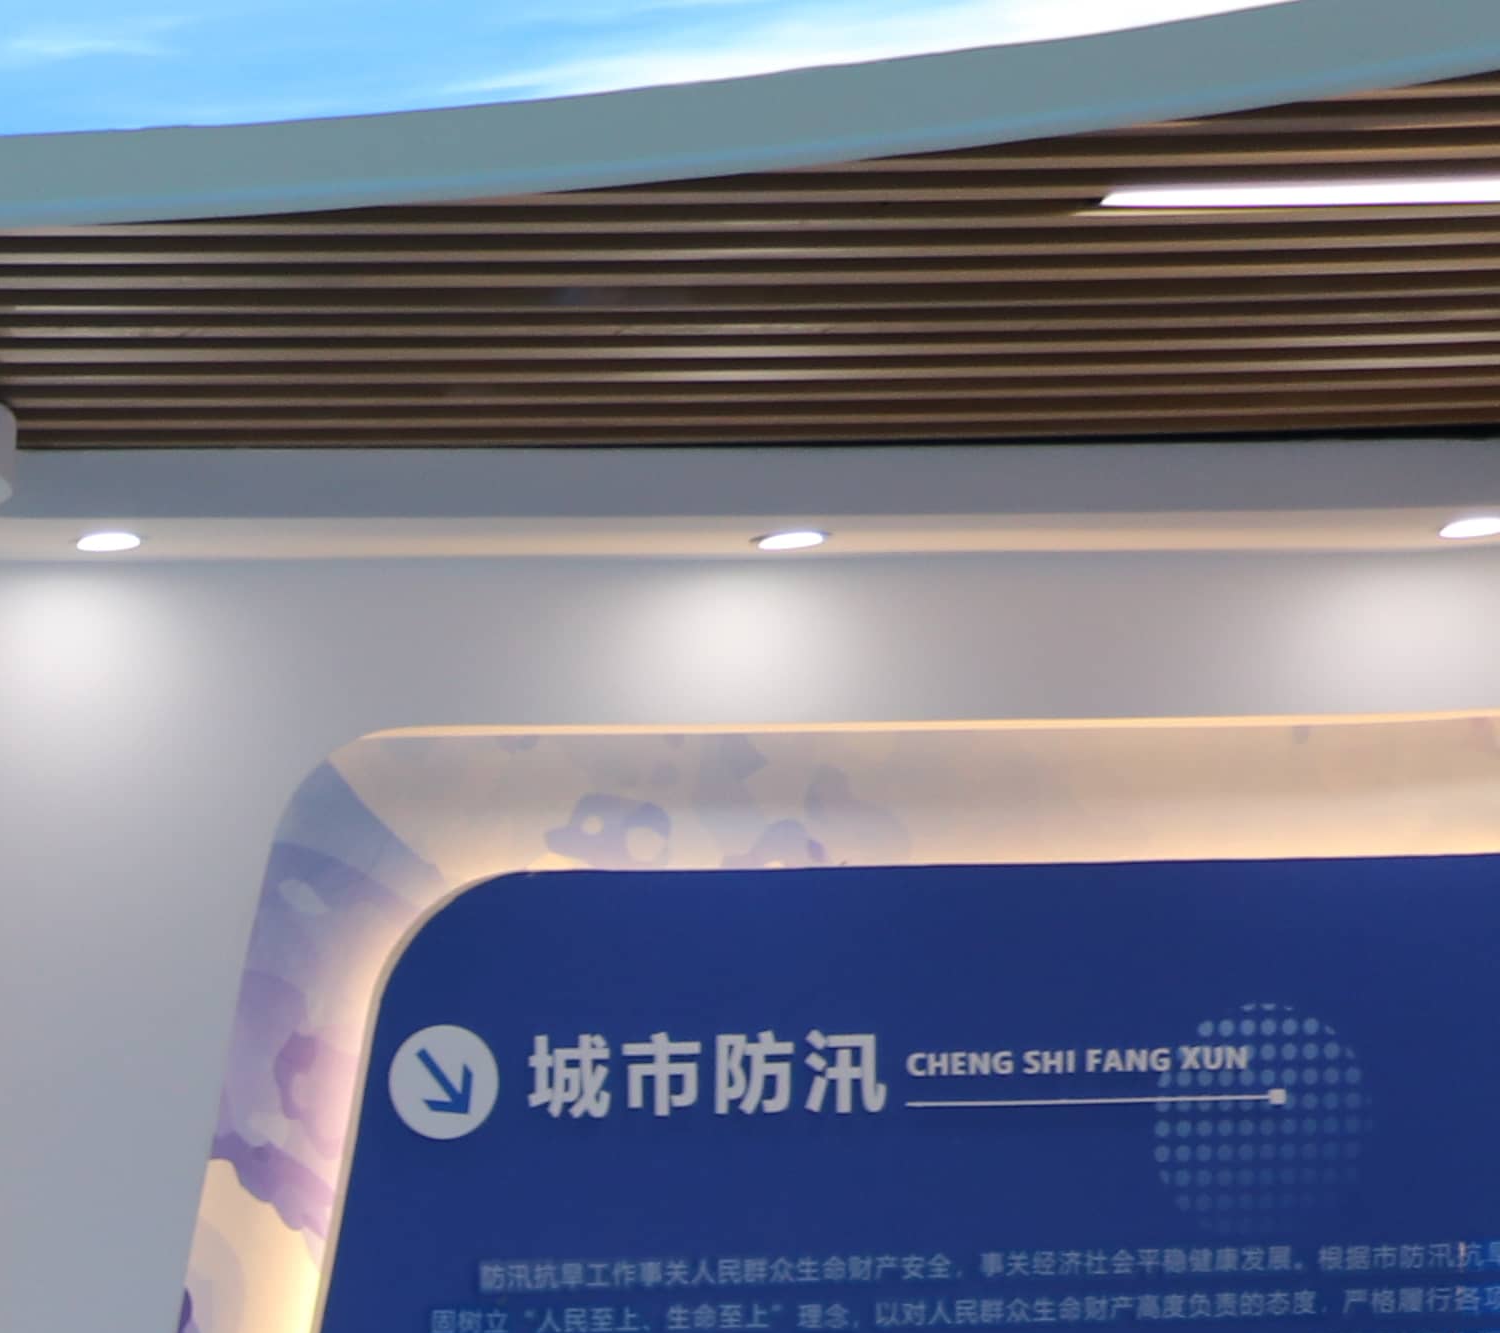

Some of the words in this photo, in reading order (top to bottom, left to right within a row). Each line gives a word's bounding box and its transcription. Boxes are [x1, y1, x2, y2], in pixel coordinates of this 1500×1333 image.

[528, 1031, 888, 1118] 城市防汛
[906, 1048, 1014, 1078] CHENG
[1023, 1047, 1076, 1076] SHI
[1084, 1045, 1172, 1075] FANG
[1178, 1043, 1250, 1072] XUN
